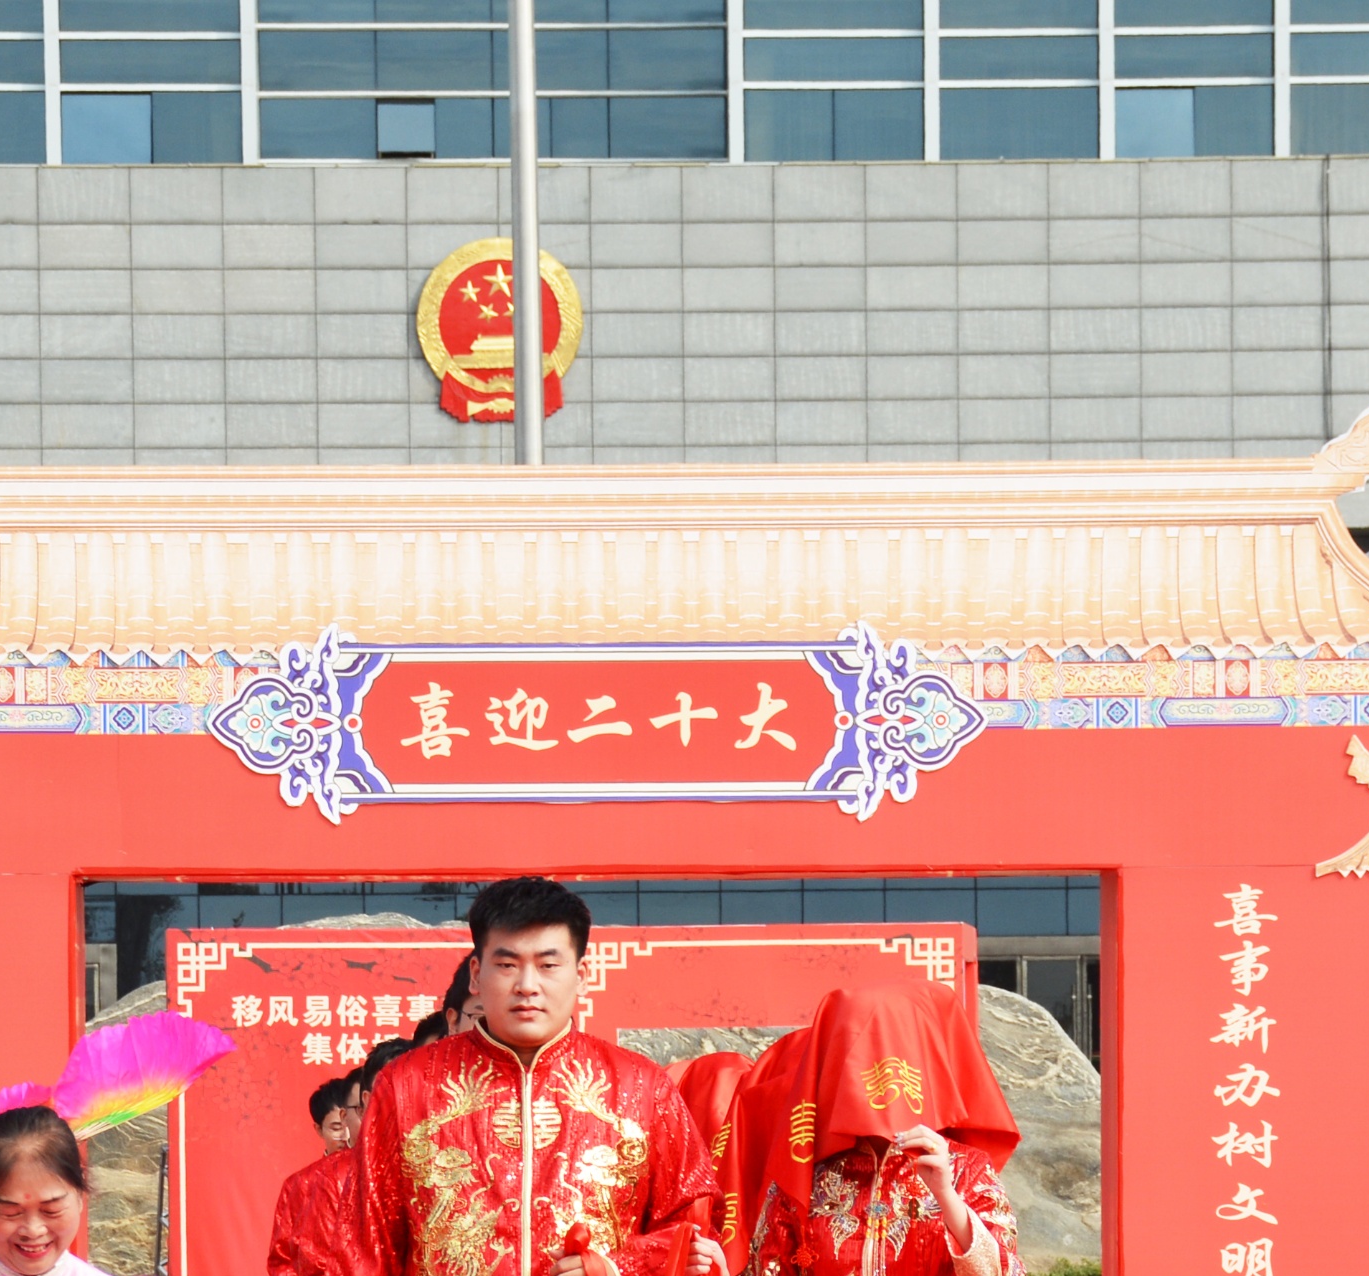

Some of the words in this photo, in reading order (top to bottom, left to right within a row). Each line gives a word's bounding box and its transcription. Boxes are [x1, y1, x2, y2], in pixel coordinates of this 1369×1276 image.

[400, 682, 797, 759] 喜迎二十大
[301, 1032, 401, 1065] 集体
